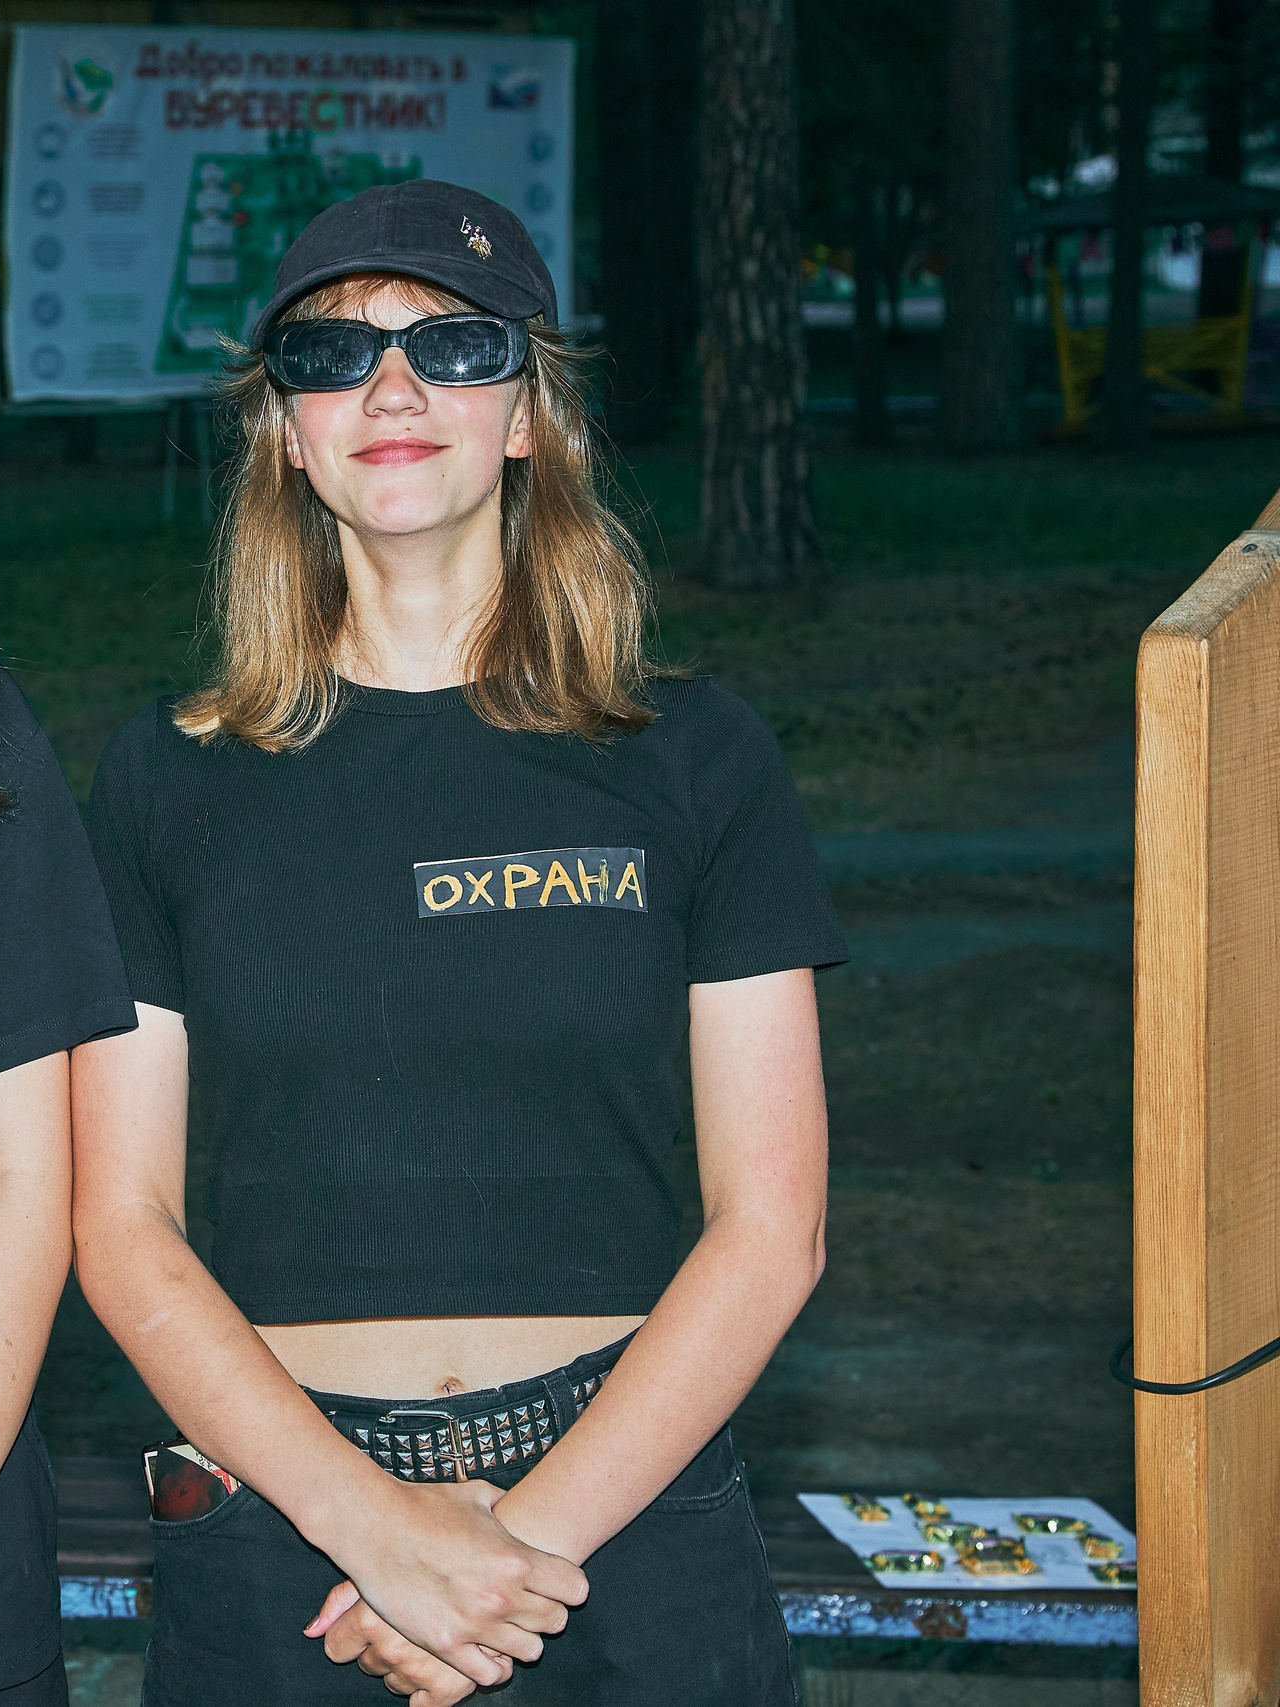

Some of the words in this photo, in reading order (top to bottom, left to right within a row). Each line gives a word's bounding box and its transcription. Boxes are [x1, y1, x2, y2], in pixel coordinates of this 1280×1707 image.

[134, 40, 243, 88] Добро
[249, 51, 442, 82] пожаловать
[451, 54, 468, 84] в
[424, 858, 643, 912] ОХРАНА
